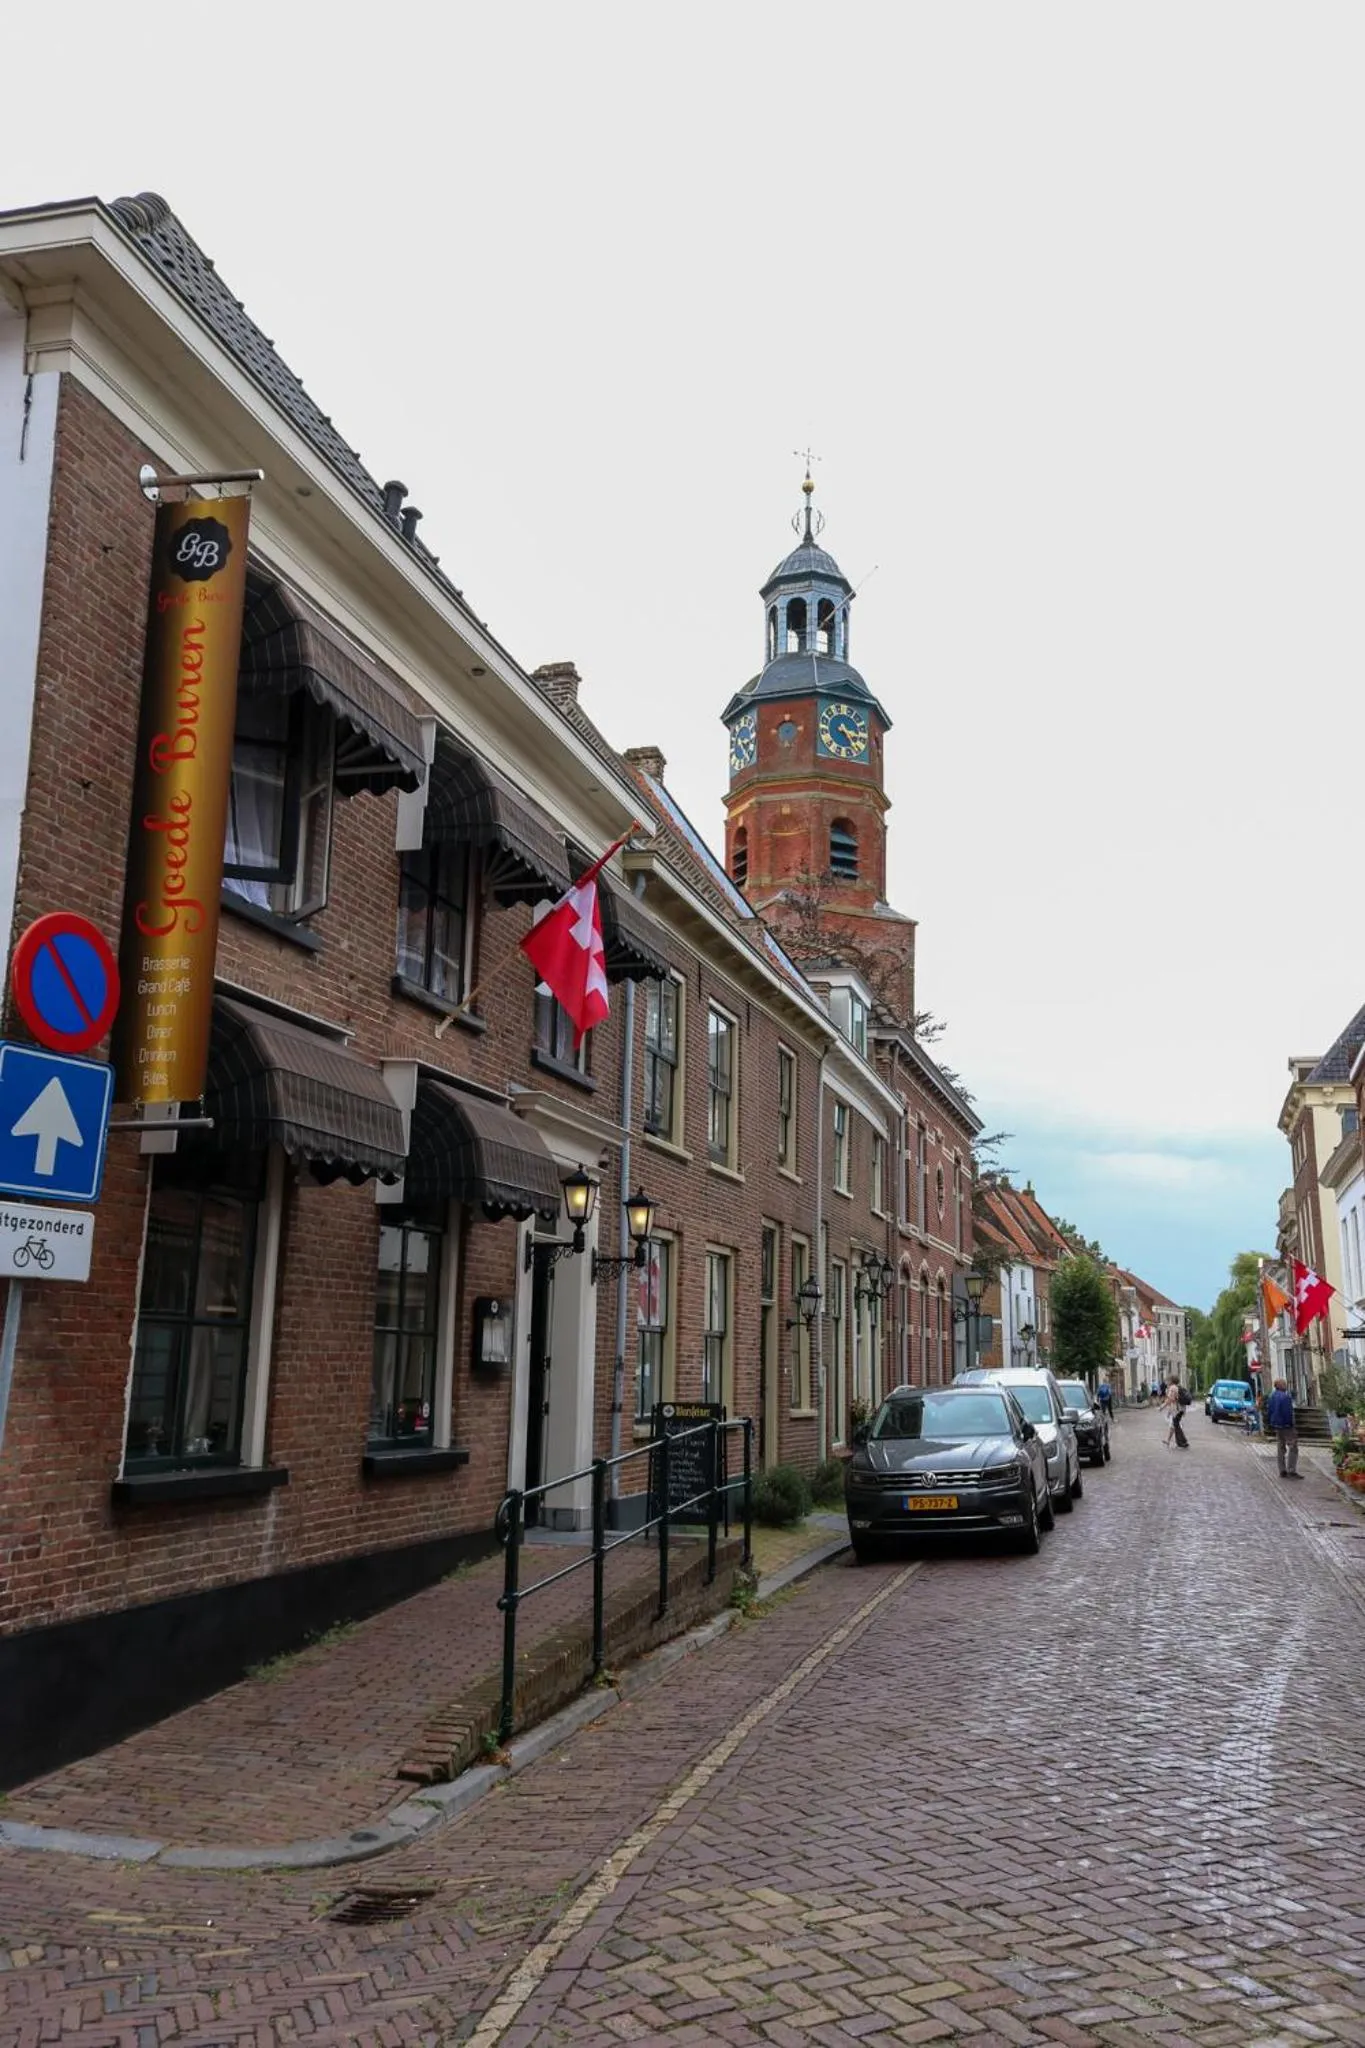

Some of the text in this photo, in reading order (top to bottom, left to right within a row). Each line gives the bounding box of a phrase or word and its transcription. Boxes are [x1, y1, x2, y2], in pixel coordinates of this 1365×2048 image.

[176, 532, 219, 568] GB
[135, 617, 207, 939] Goede Buren
[142, 955, 191, 972] Brasserie
[137, 977, 167, 995] Grand
[147, 1002, 177, 1017] Lunch
